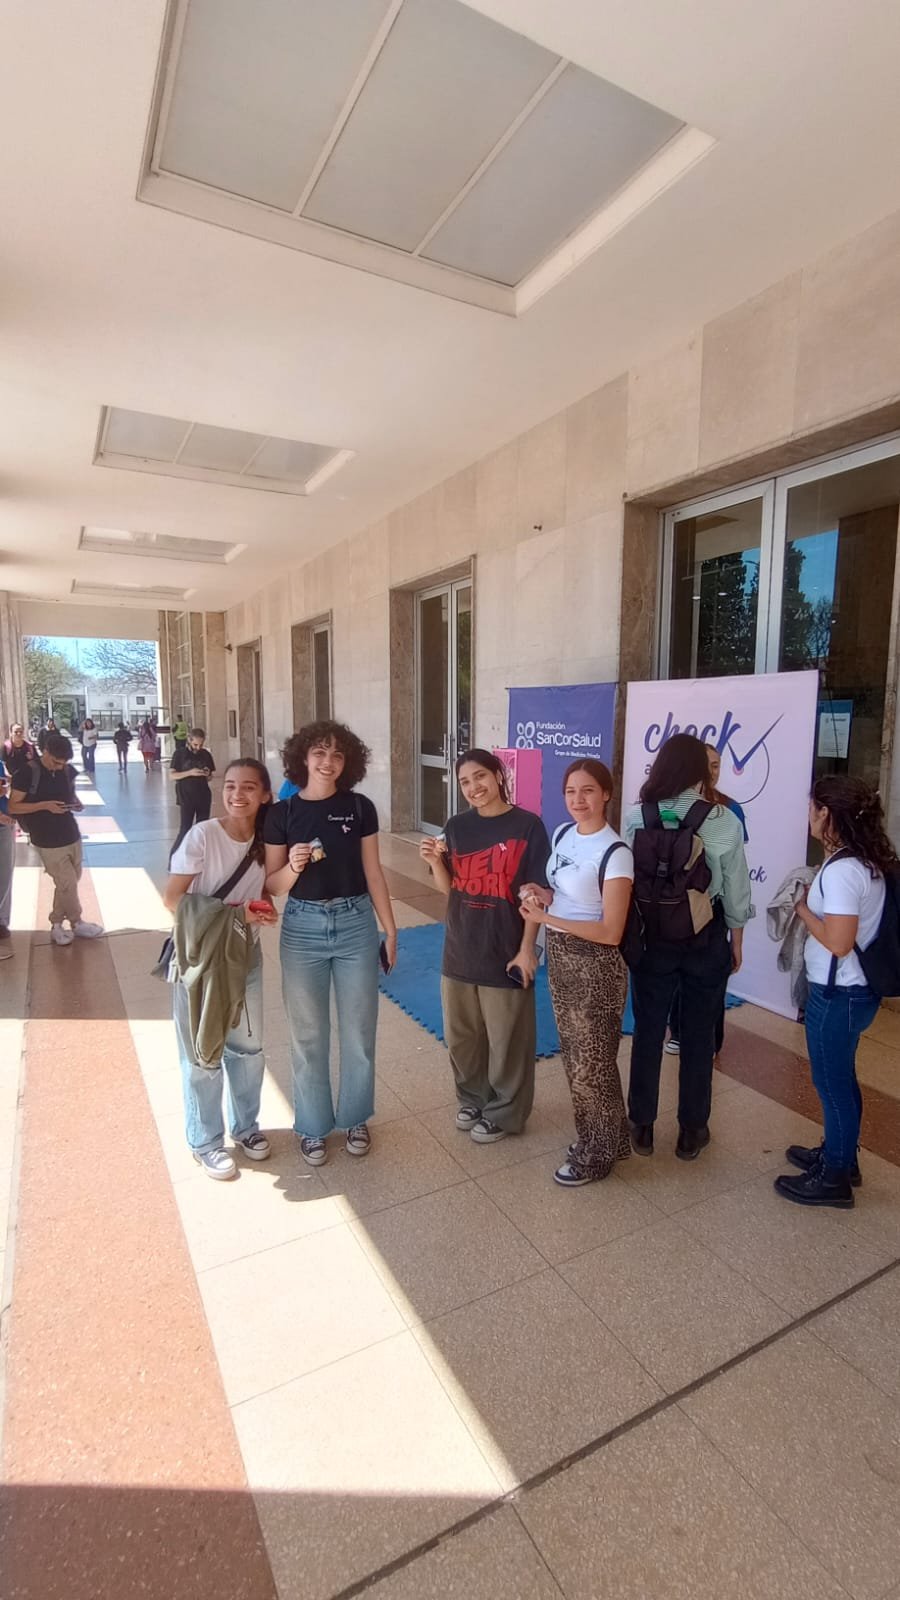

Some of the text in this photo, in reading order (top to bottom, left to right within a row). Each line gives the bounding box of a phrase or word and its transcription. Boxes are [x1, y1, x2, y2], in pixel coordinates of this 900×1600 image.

[536, 721, 566, 730] Fundación
[536, 731, 601, 748] SanCorSalud
[452, 838, 528, 879] NEW
[451, 872, 515, 904] YORK
